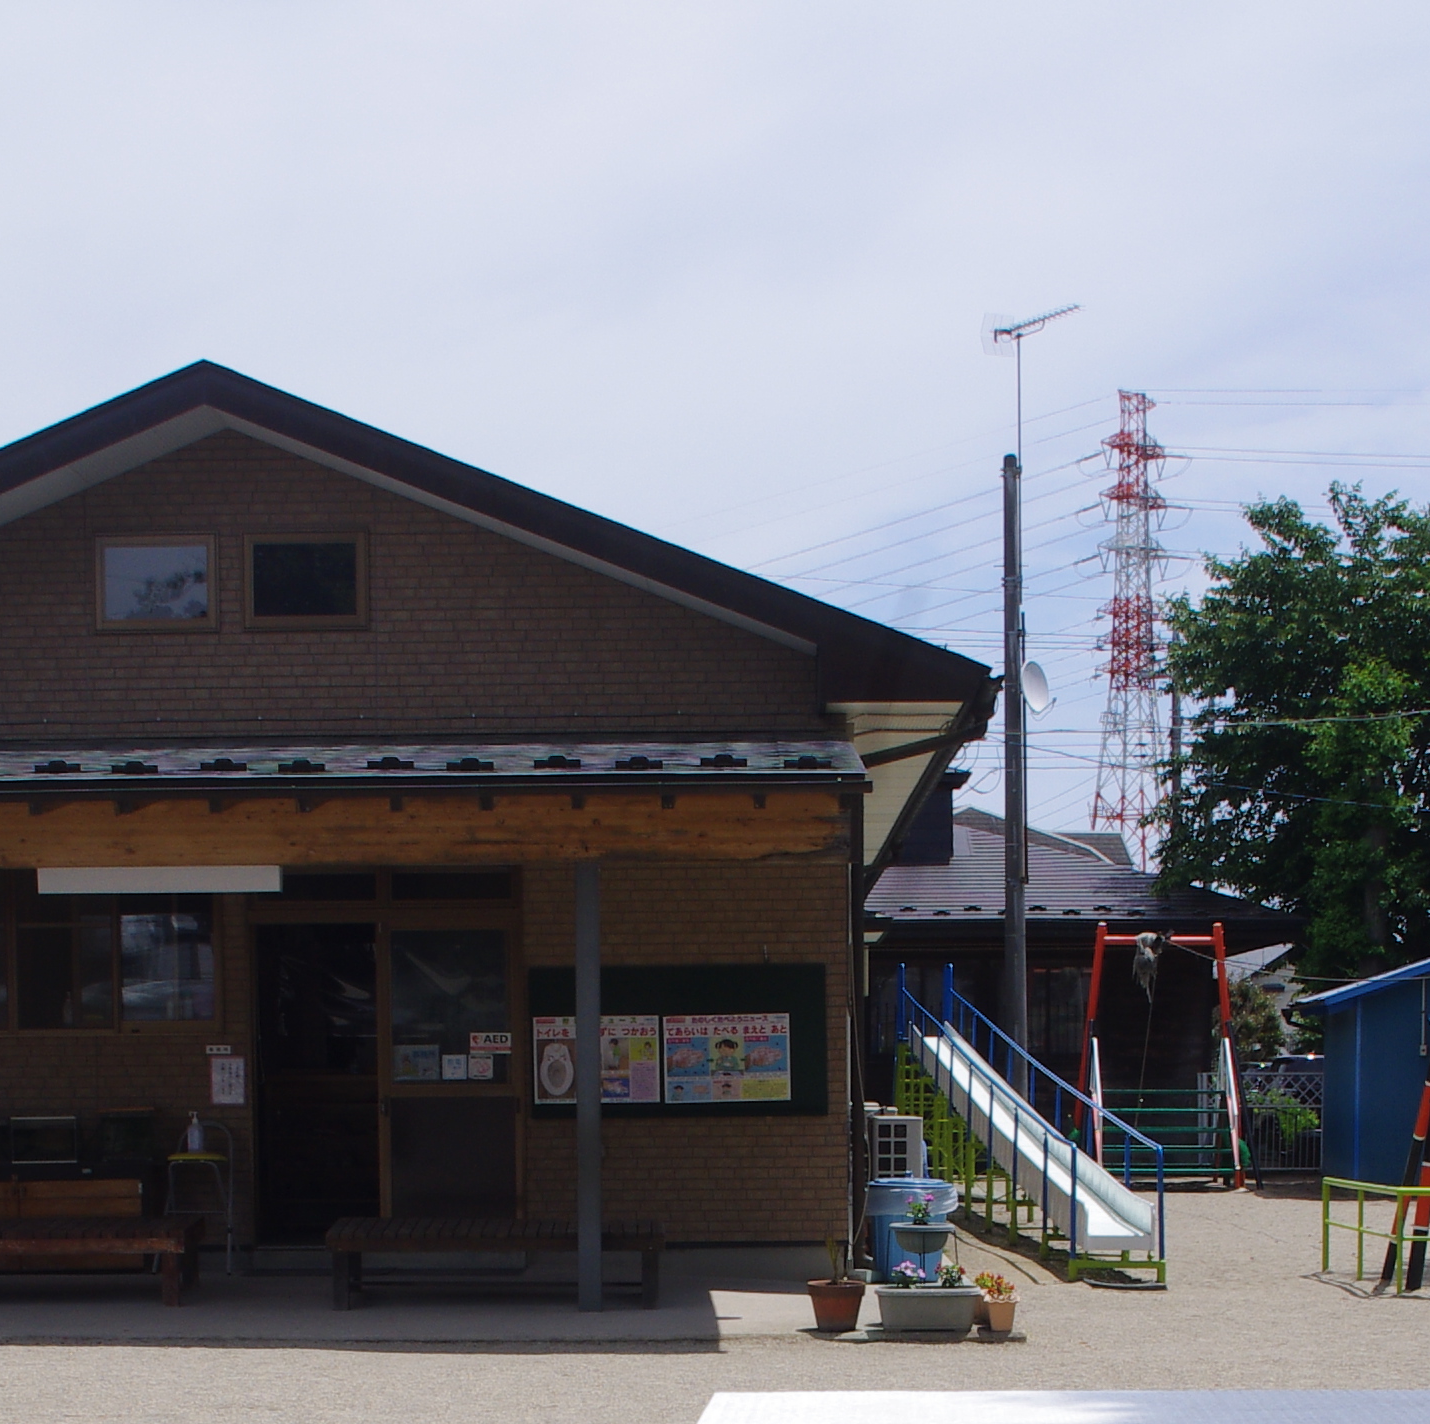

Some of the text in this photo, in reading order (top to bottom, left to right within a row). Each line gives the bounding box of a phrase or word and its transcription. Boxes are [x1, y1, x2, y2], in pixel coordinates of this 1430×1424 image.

[536, 1028, 570, 1038] トイレを
[622, 1027, 657, 1036] つかおう
[666, 1025, 787, 1036] てあらいは たべる まえと あと
[483, 1035, 508, 1044] AED
